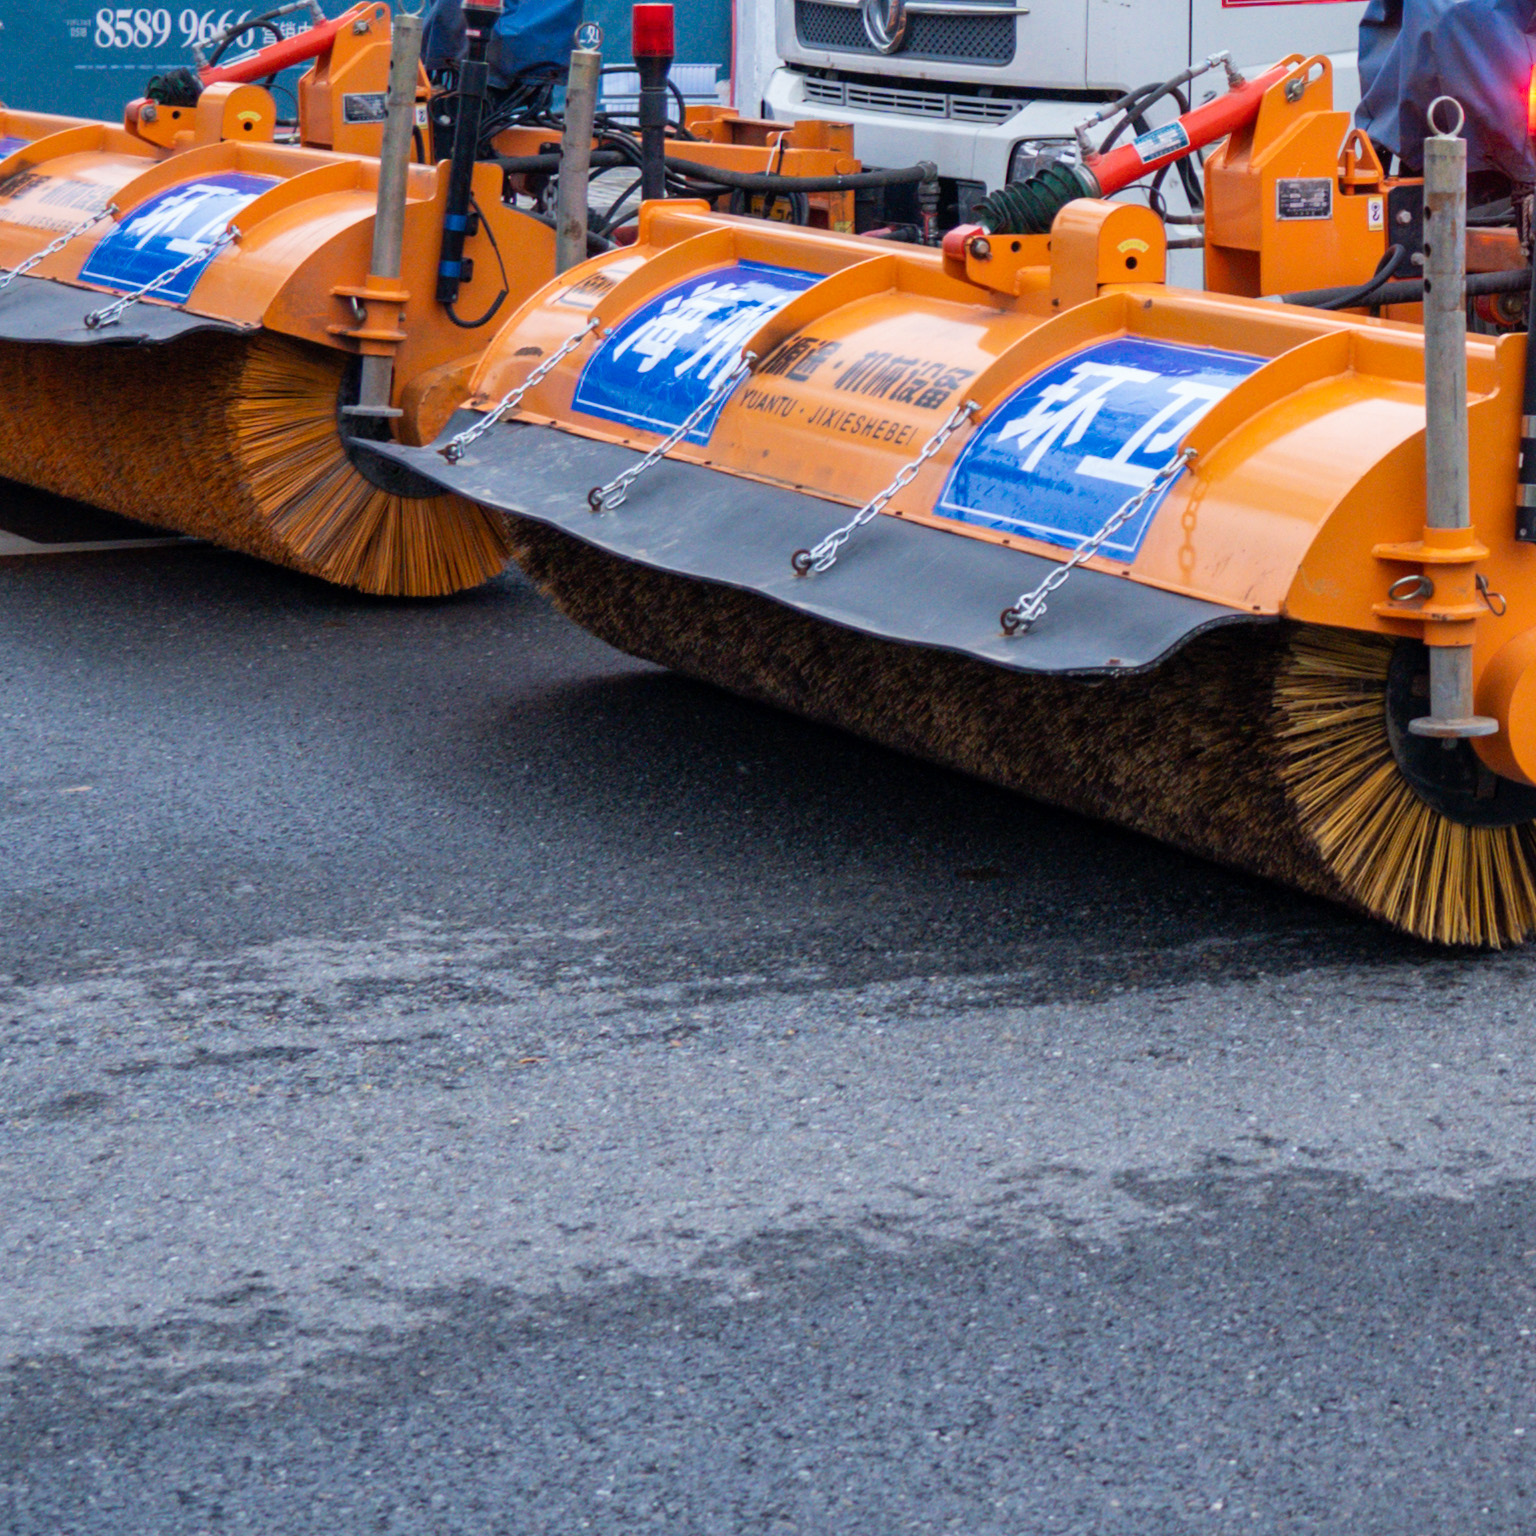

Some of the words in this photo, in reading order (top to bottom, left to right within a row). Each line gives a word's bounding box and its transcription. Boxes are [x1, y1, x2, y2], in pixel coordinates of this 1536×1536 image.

[95, 8, 172, 49] 8589
[740, 389, 798, 418] YUANTU
[996, 360, 1233, 488] 环卫
